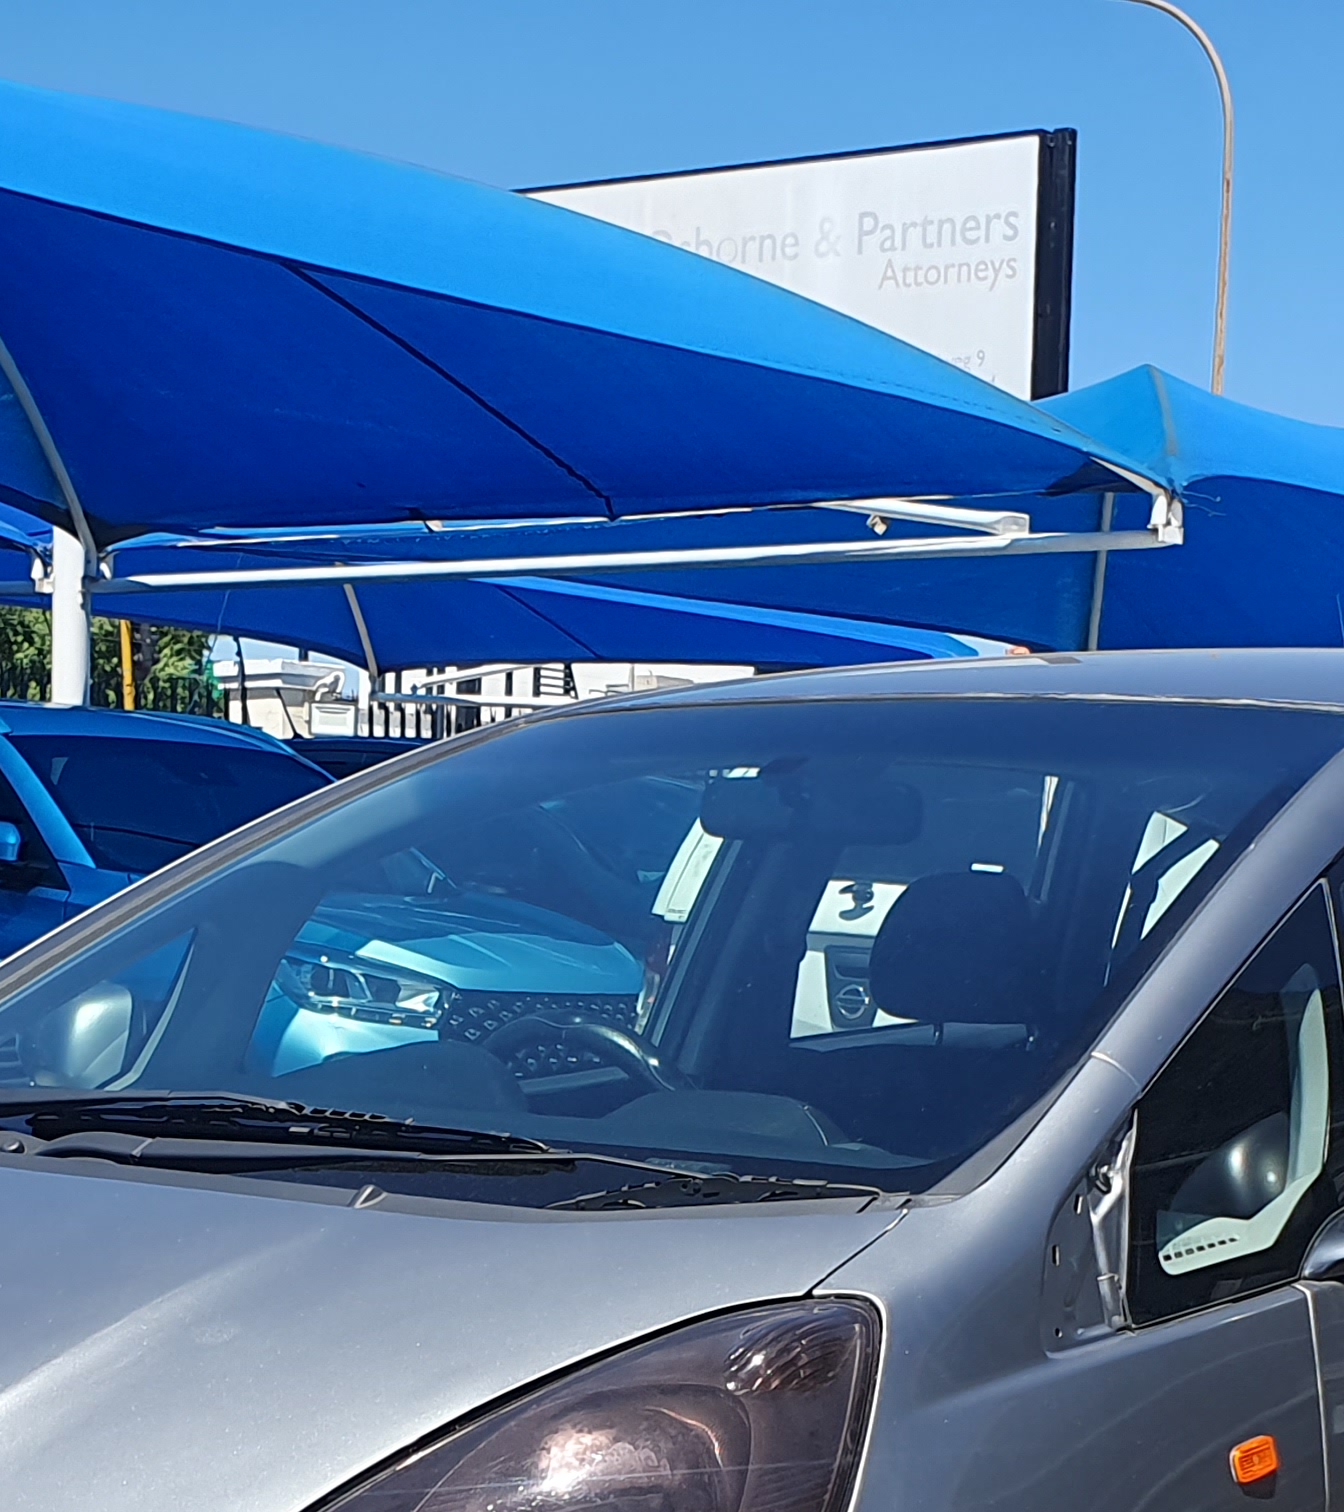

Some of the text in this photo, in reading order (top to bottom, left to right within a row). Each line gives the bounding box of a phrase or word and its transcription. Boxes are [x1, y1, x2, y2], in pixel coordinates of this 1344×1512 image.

[813, 215, 842, 259] &
[856, 209, 1021, 256] Partners
[877, 256, 1019, 292] Attorneys
